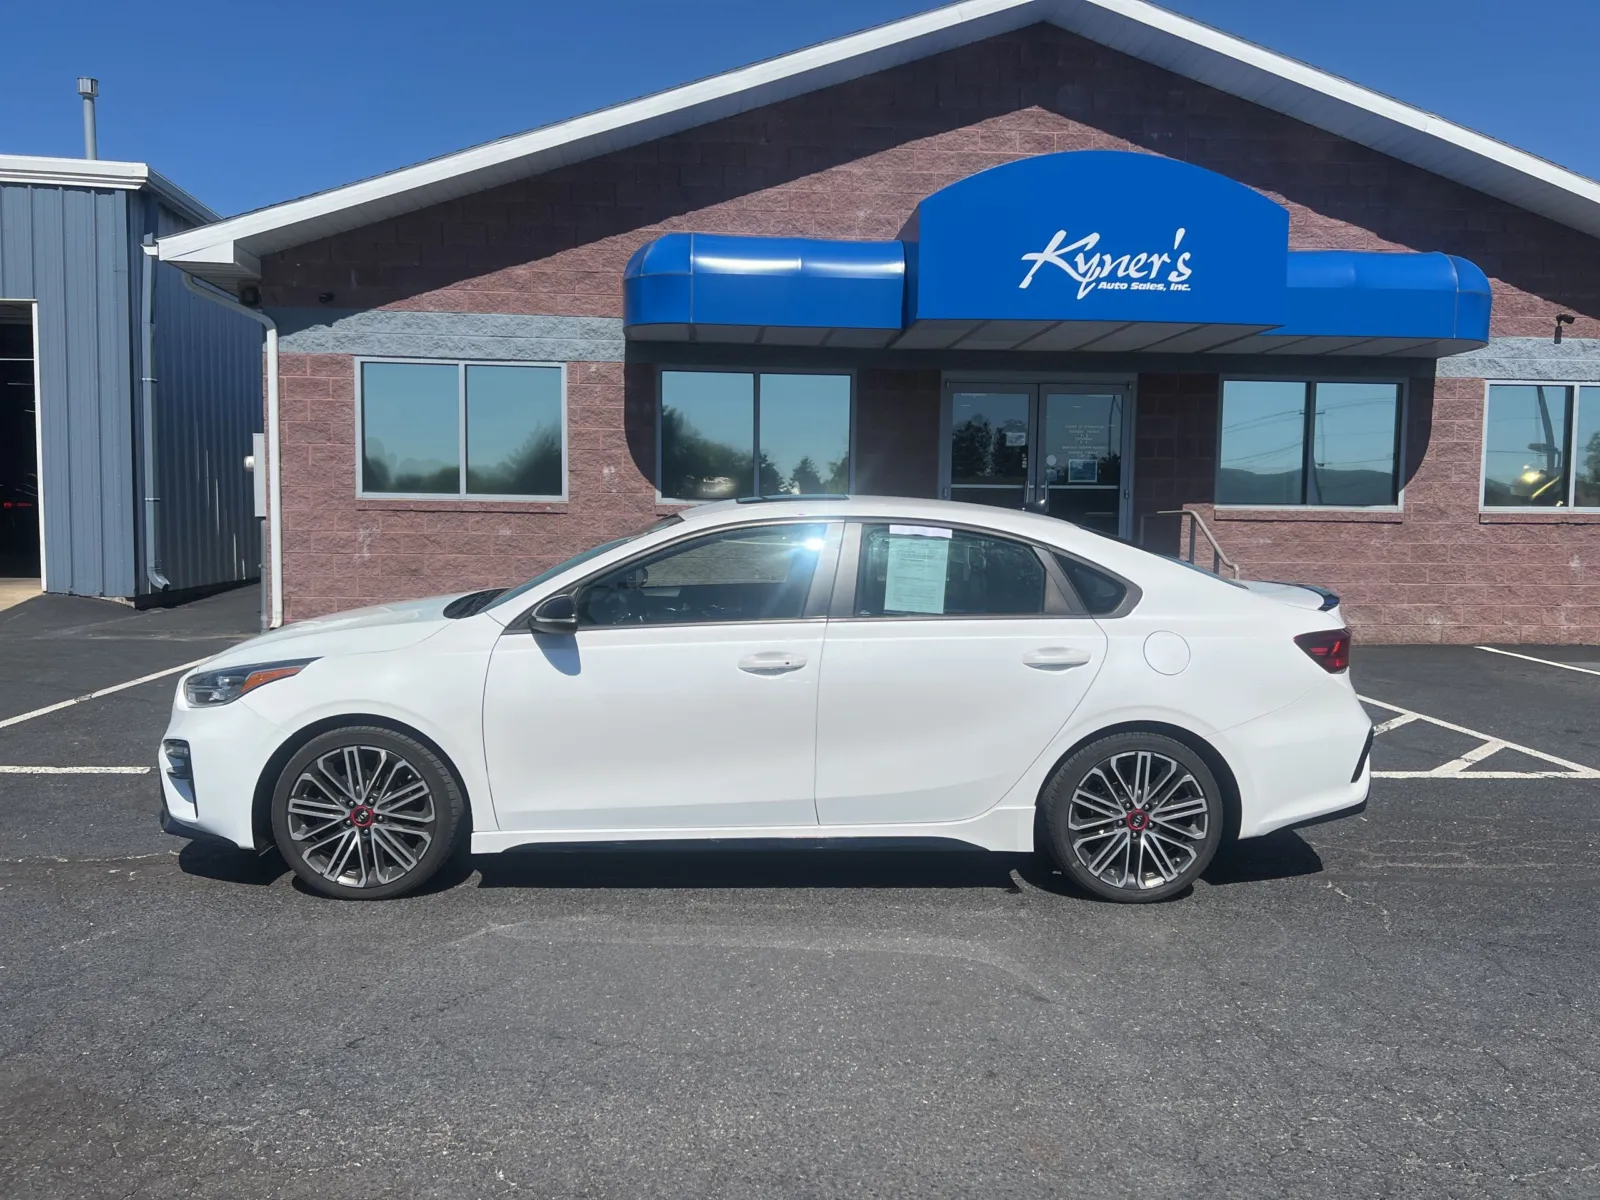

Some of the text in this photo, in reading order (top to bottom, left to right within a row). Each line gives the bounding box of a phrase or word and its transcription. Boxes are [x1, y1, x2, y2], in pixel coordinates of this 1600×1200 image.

[1018, 228, 1192, 300] Kyner's
[1097, 281, 1192, 292] Auto Sales, Inc.
